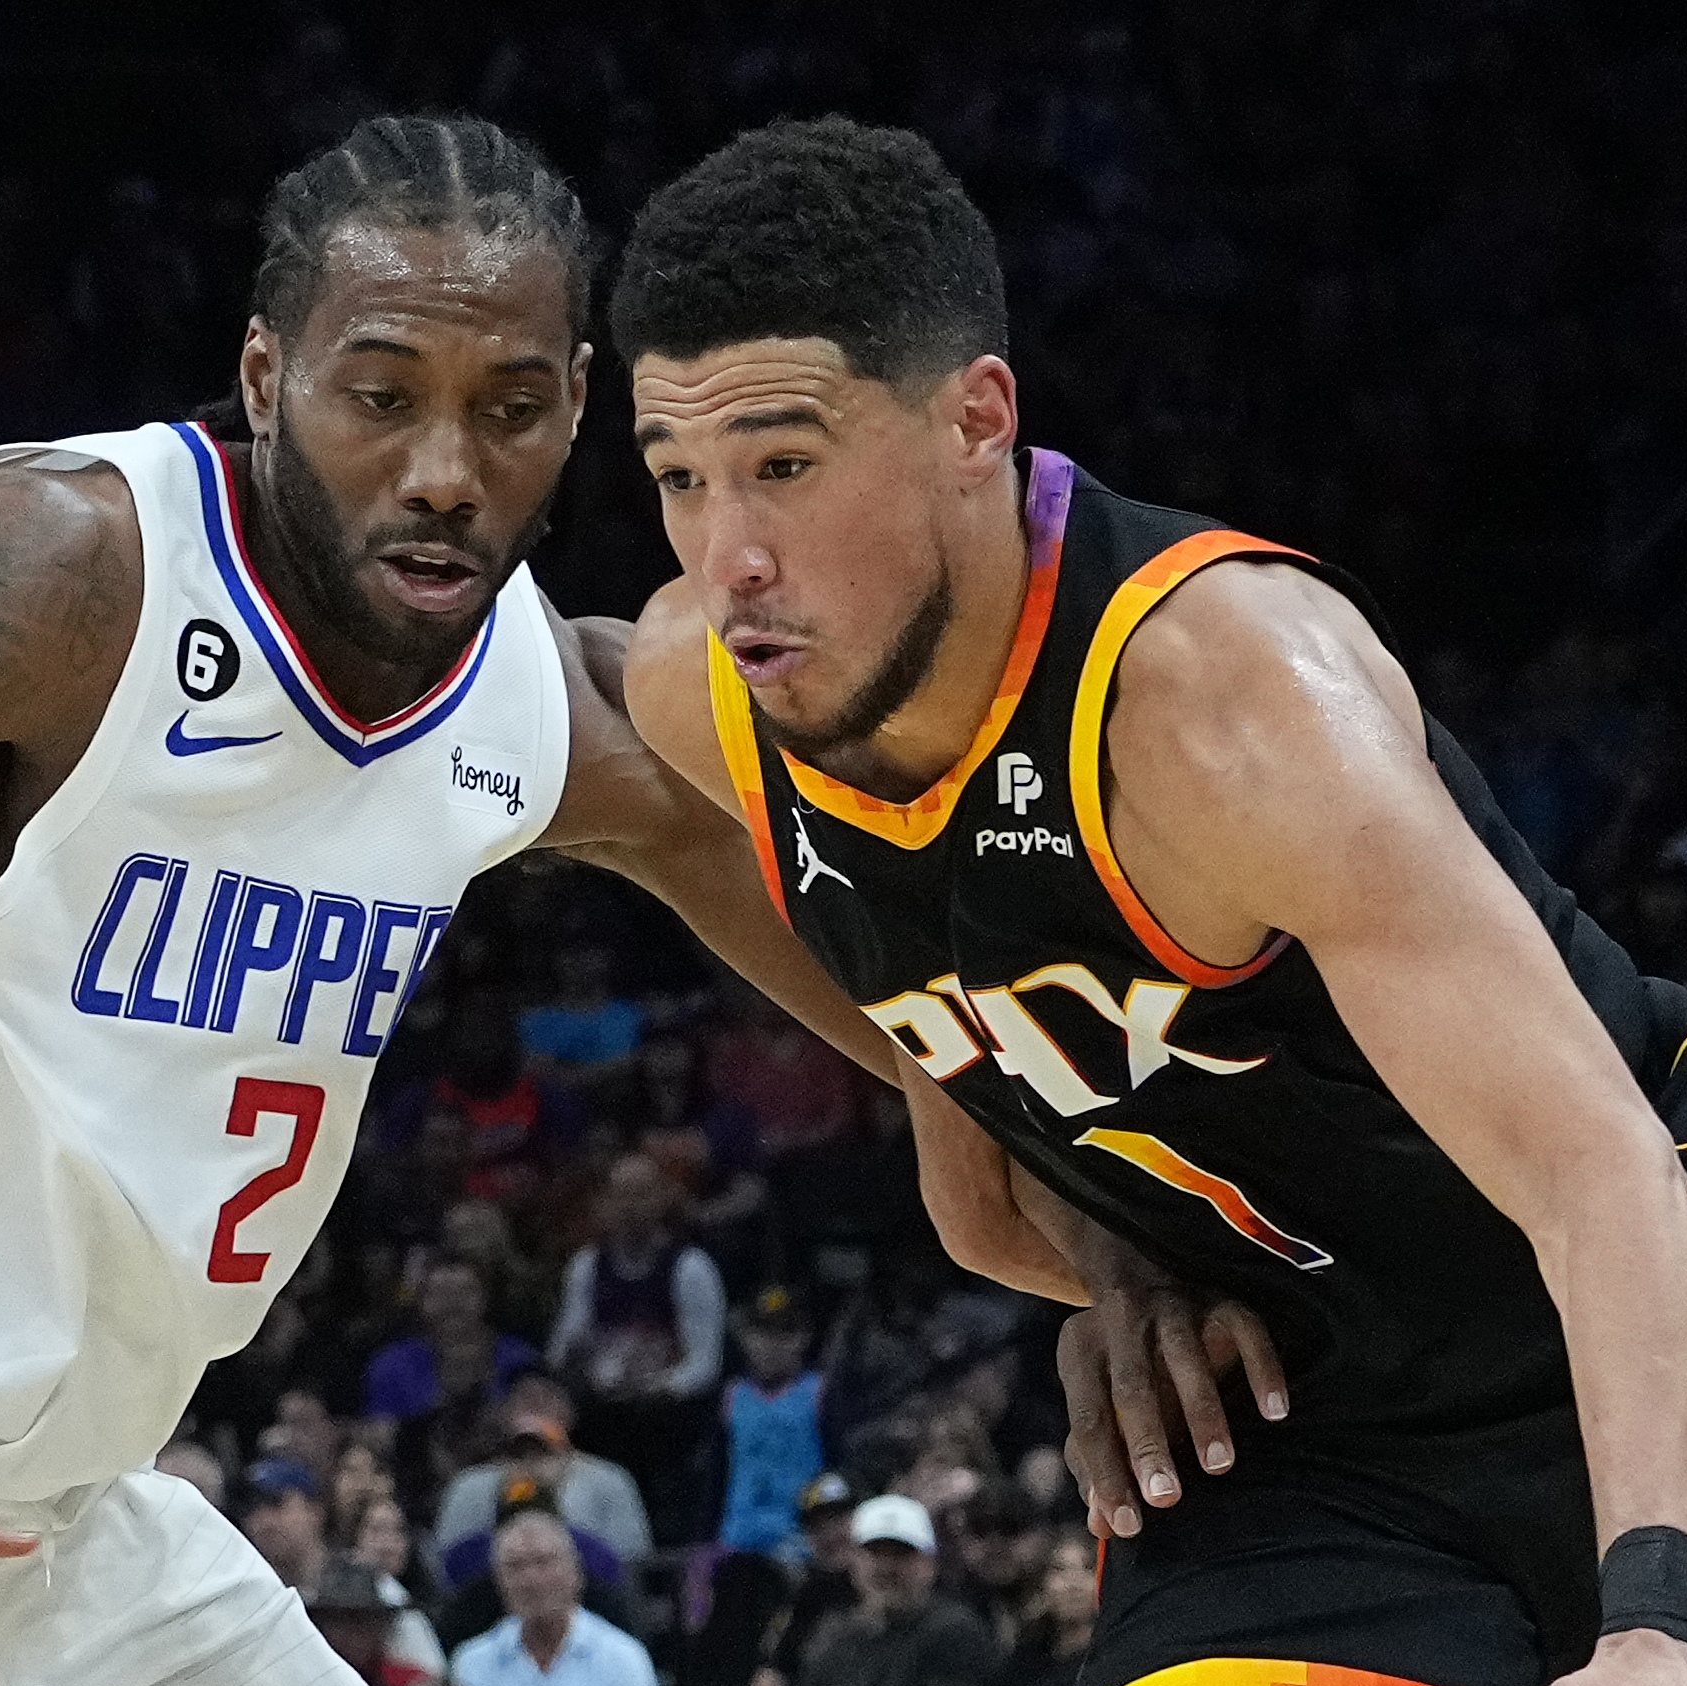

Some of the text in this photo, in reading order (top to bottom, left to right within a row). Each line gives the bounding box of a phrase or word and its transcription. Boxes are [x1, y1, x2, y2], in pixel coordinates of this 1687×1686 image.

[185, 631, 224, 693] 6
[451, 746, 524, 815] honey
[975, 826, 1074, 858] PayPal
[207, 1076, 325, 1283] 2
